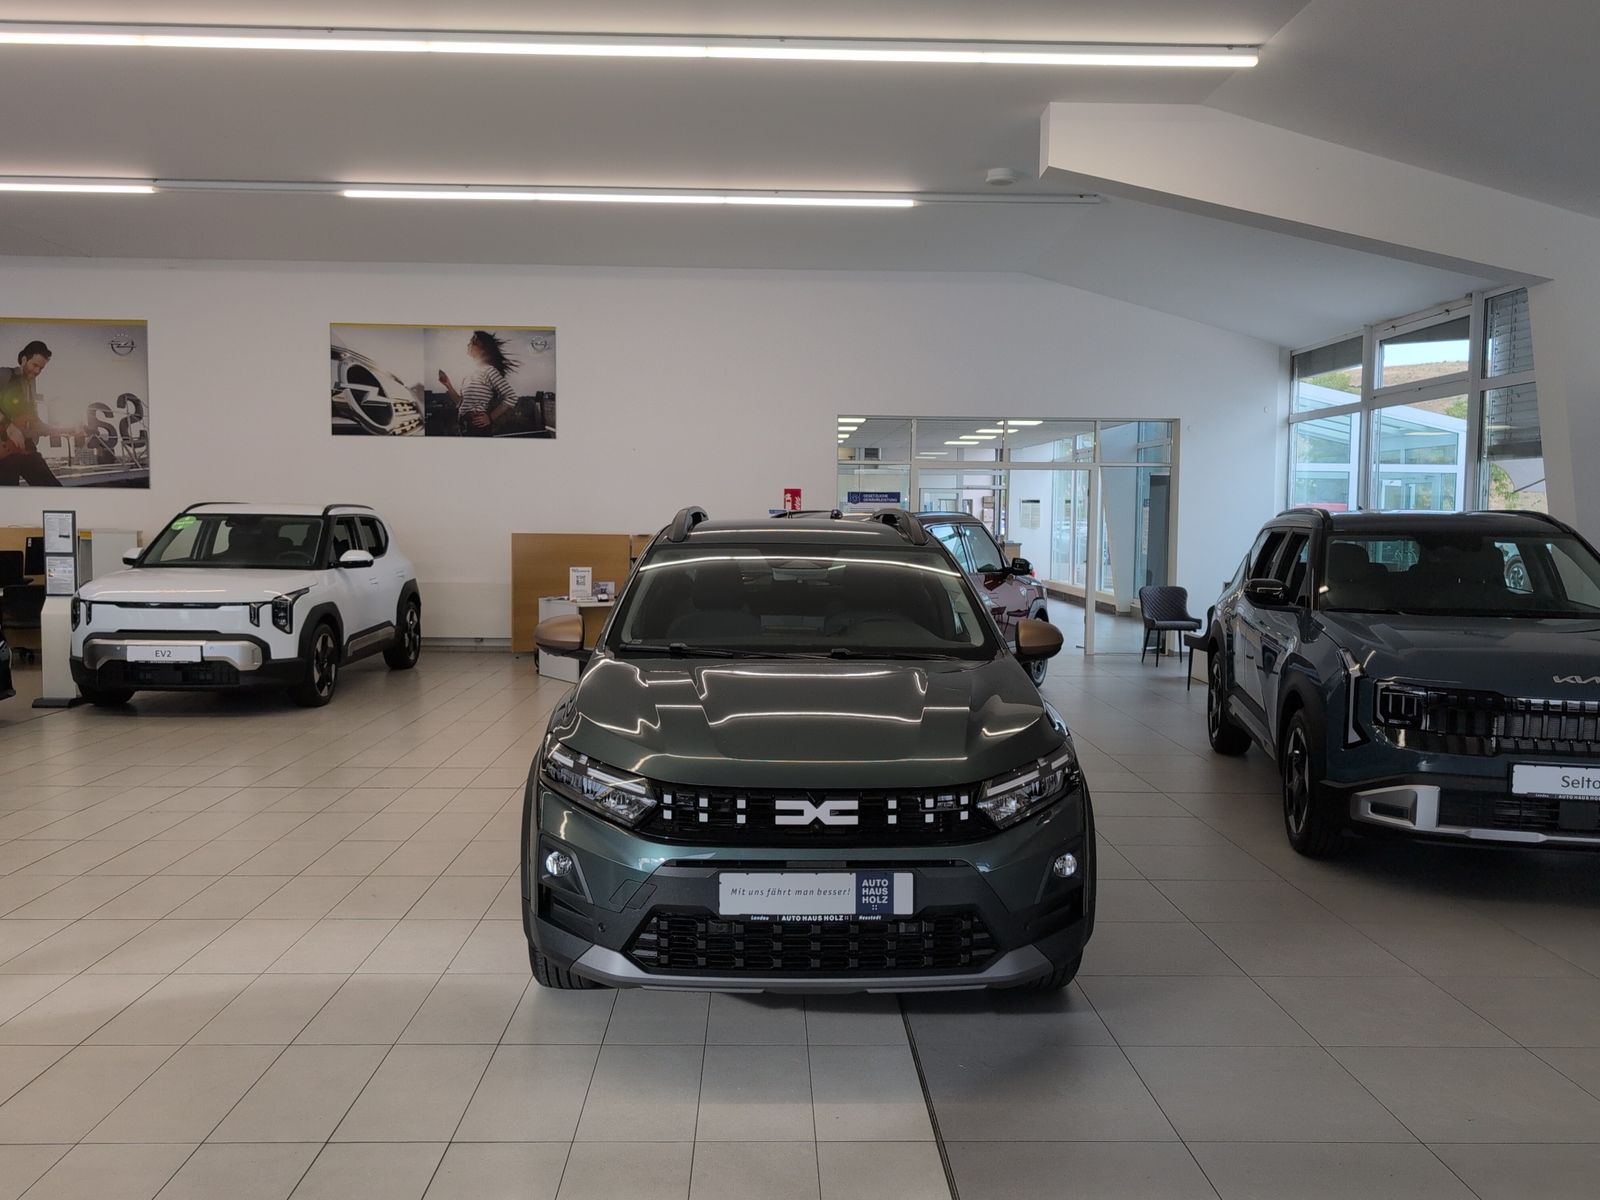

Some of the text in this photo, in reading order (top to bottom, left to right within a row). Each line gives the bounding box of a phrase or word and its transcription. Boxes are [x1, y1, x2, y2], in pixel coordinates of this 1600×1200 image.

[155, 650, 172, 658] EV2
[862, 879, 889, 887] AUTO
[730, 887, 851, 898] Mit uns fährt man besser!
[862, 887, 889, 895] HAUS
[862, 896, 889, 904] HOLZ
